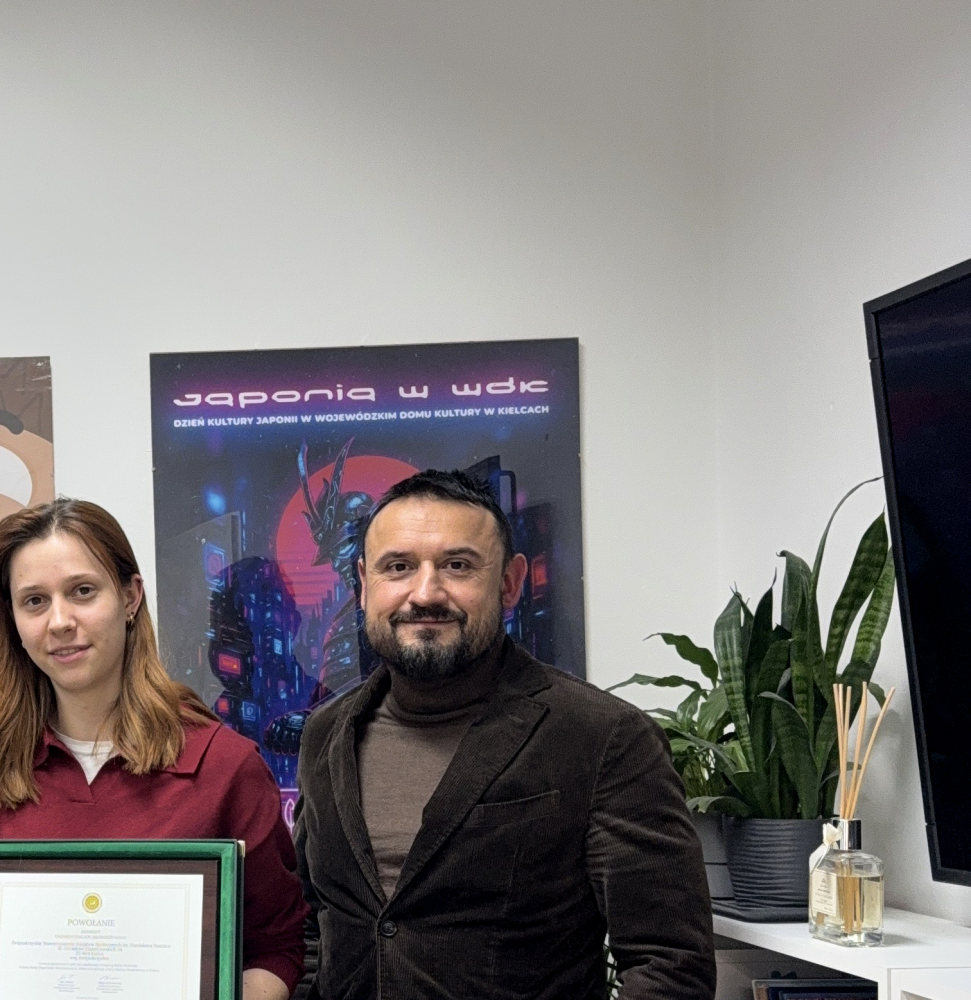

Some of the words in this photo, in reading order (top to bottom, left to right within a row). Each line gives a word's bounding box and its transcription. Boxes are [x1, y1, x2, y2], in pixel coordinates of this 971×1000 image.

[173, 417, 205, 428] DZIEŃ
[207, 417, 254, 427] KULTURY
[256, 416, 298, 425] JAPONII
[300, 415, 312, 423] W
[314, 411, 397, 422] WOJEWÓDZKIM
[399, 410, 432, 419] DOMU
[434, 408, 481, 418] KULTURY
[484, 407, 495, 416] W
[497, 405, 550, 415] KIELCACH
[67, 918, 115, 927] POWOŁANIE
